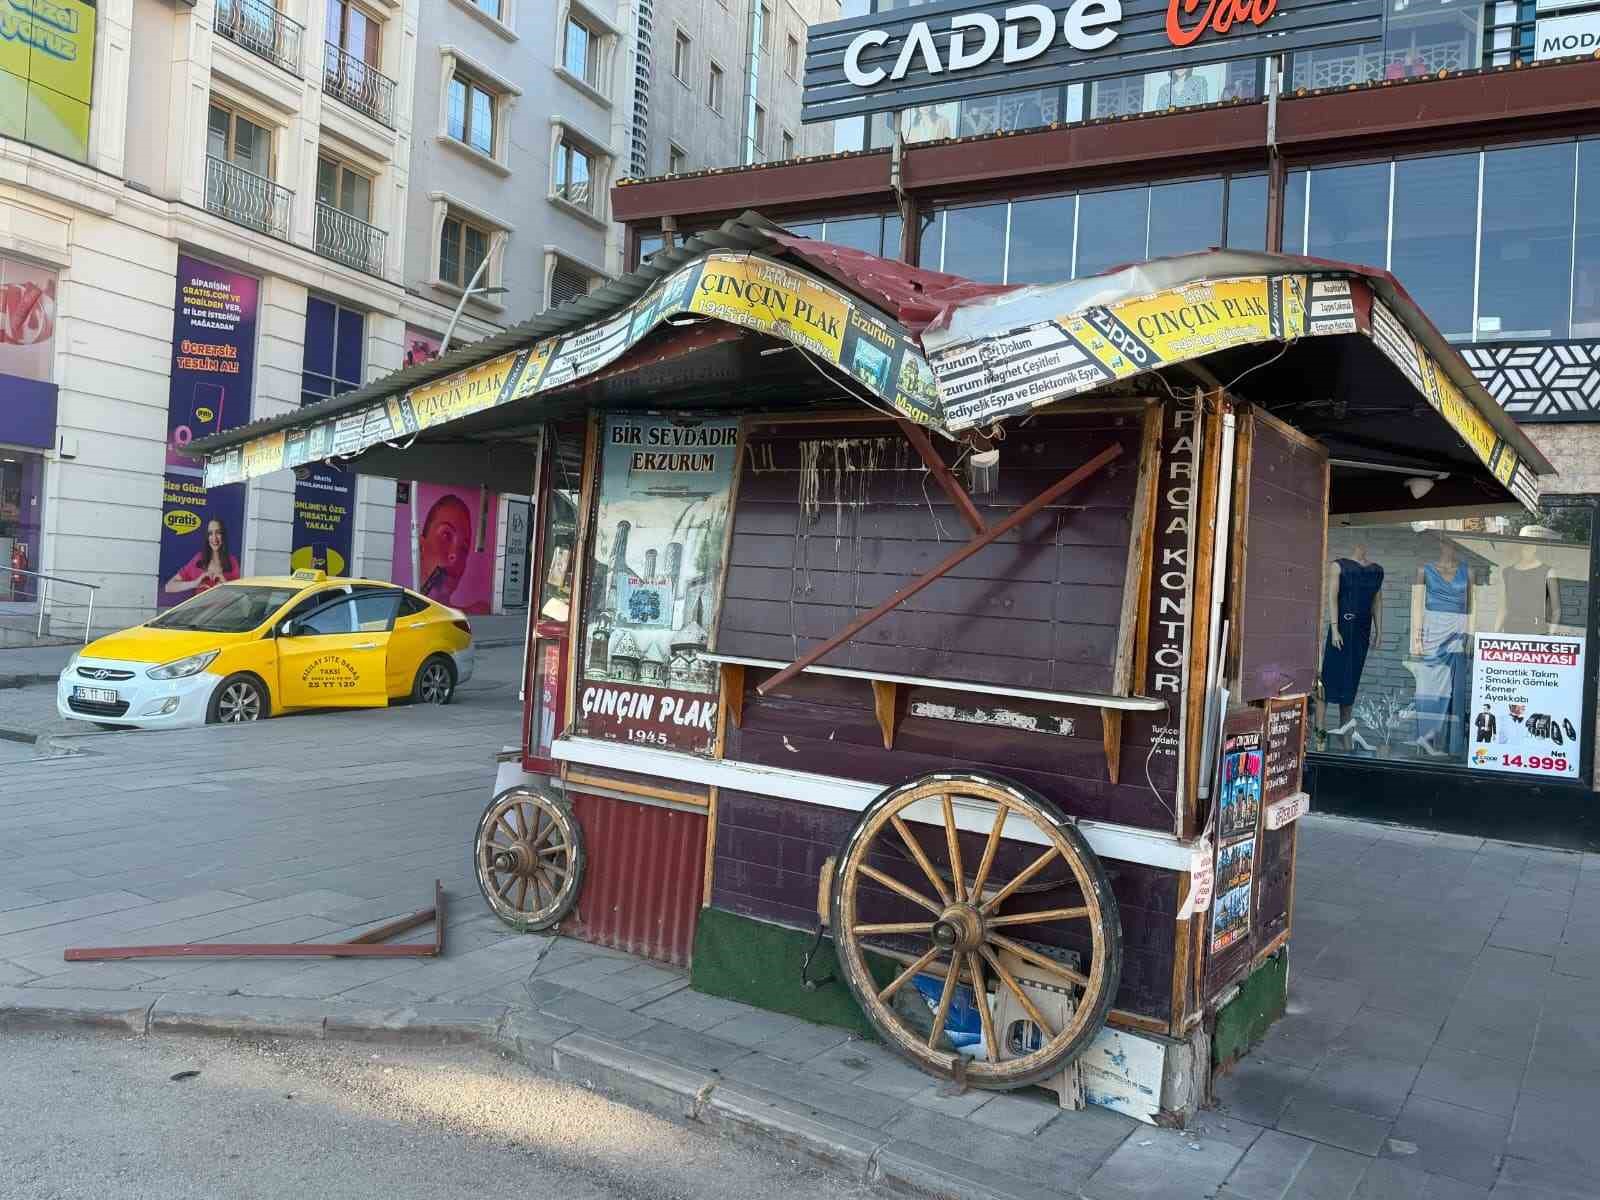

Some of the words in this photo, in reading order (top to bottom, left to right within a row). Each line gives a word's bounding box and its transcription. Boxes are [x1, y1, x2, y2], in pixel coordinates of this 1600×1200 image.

[1222, 296, 1267, 318] PLAK
[793, 298, 841, 340] PLAK
[851, 310, 896, 350] Erzurum
[930, 354, 978, 377] rzurum
[944, 378, 984, 397] zurum
[1022, 352, 1061, 374] Çeşitleri
[991, 393, 1014, 408] Eşya
[1016, 387, 1027, 399] ve
[1029, 373, 1078, 396] Elektronik
[1078, 367, 1100, 382] Eşya
[610, 421, 642, 446] BİR
[648, 427, 738, 447] SEVDADIR
[632, 451, 716, 472] ERZURUM
[168, 513, 197, 526] gratis
[1480, 640, 1549, 654] DAMATLIK
[1551, 644, 1576, 655] SET
[1483, 651, 1575, 665] KAMPANYASI
[1485, 676, 1521, 686] Smokin
[1522, 678, 1560, 688] Gömlek
[1531, 669, 1560, 679] Takım
[1485, 685, 1517, 694] Kemer
[1485, 693, 1529, 704] Ayakkabı
[659, 696, 718, 731] PLAK
[628, 728, 668, 745] 1945
[1551, 750, 1566, 758] Net
